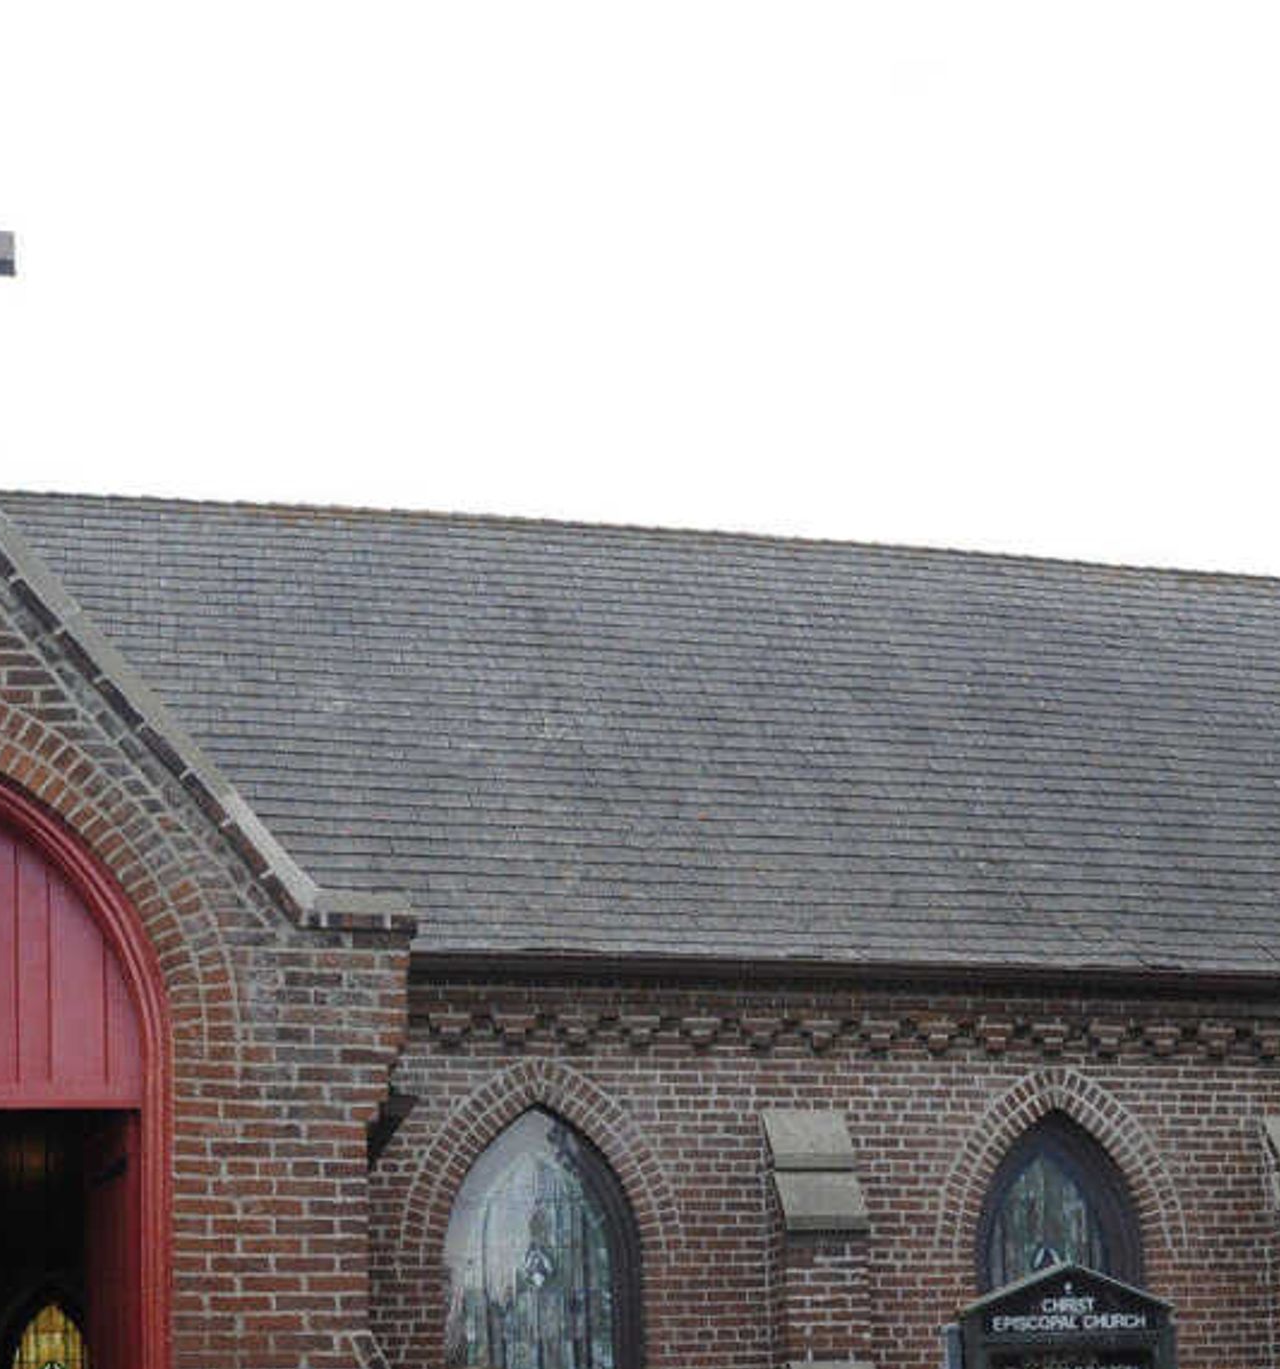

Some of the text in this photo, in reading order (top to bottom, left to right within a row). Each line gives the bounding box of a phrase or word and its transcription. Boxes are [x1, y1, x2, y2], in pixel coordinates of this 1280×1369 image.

[1042, 1297, 1095, 1312] CHRIST
[992, 1312, 1147, 1331] EPISCOPAL CHURCH
